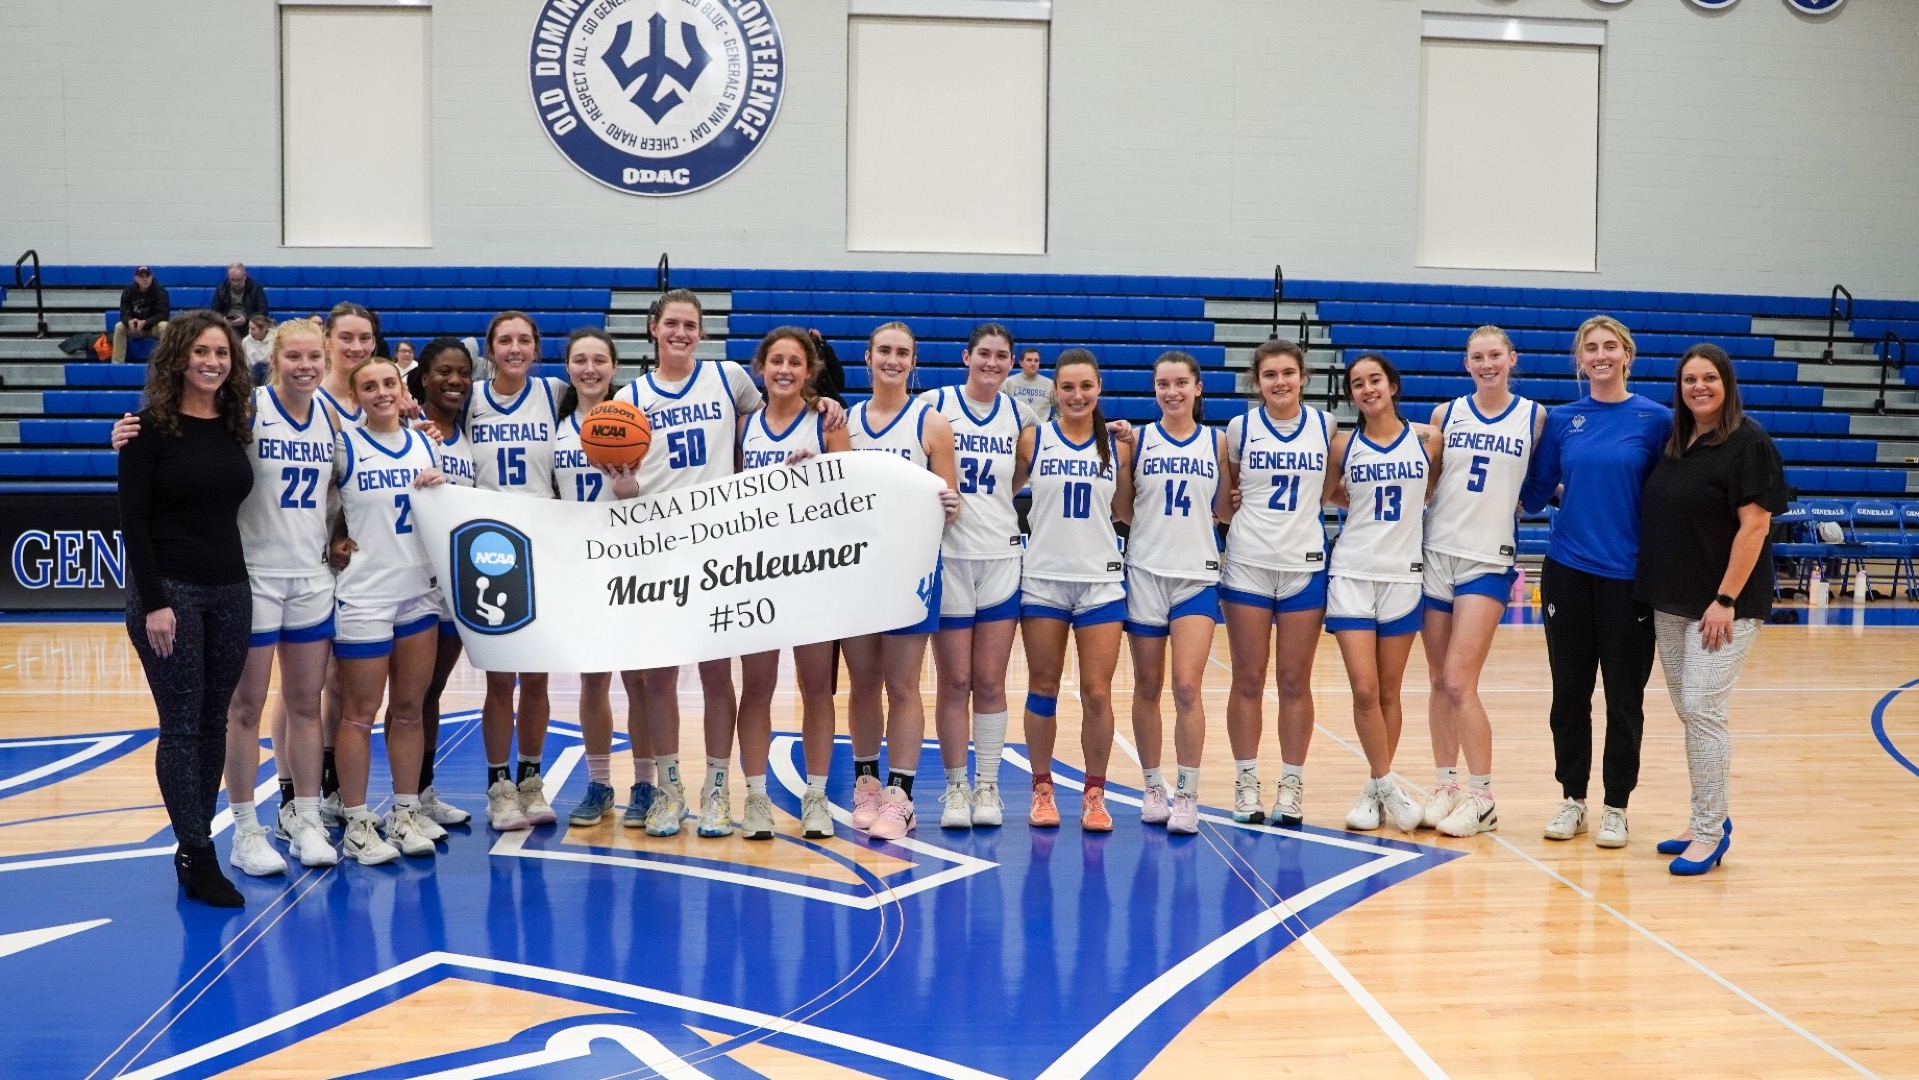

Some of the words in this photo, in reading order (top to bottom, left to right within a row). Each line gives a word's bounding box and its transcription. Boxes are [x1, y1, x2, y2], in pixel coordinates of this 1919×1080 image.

[582, 18, 598, 35] GO
[700, 2, 728, 30] BLUE
[536, 0, 585, 75] DOMIN
[573, 46, 588, 66] ALL
[723, 38, 740, 100] GENERALS
[573, 71, 603, 121] RESPECT
[540, 88, 577, 136] OLD
[708, 102, 731, 126] WIN
[606, 123, 638, 147] HARD
[641, 137, 679, 151] CHEER
[689, 122, 711, 142] DAY
[623, 167, 690, 185] ODAC
[1014, 387, 1046, 397] LACROSSE
[472, 423, 548, 444] GENERALS
[591, 425, 626, 438] NCAA
[954, 433, 1013, 455] ENERALS
[1448, 432, 1524, 457] GENERALS
[258, 438, 333, 463] GENERALS
[554, 450, 590, 469] GENE
[667, 428, 707, 469] 50
[1250, 451, 1323, 471] GENERALS
[497, 447, 527, 486] 15
[960, 458, 996, 494] 34
[1143, 457, 1214, 479] GENERALS
[1351, 461, 1424, 483] GENERALS
[1467, 456, 1490, 492] 5
[280, 467, 319, 508] 22
[576, 473, 602, 501] 12
[609, 496, 683, 527] NCAA
[690, 465, 810, 512] DIVISION
[816, 459, 845, 484] III
[1063, 481, 1092, 519] 10
[1165, 479, 1191, 517] 14
[1269, 475, 1300, 511] 21
[395, 493, 413, 534] 2
[1375, 486, 1402, 521] 13
[1812, 508, 1845, 516] GENERALS
[1857, 508, 1894, 516] GENERALS
[586, 508, 780, 560] Double-Double
[787, 492, 877, 524] Leader
[475, 552, 516, 566] NCAA
[607, 575, 690, 607] Mary
[700, 541, 869, 591] Schleusner
[709, 598, 776, 633] #50
